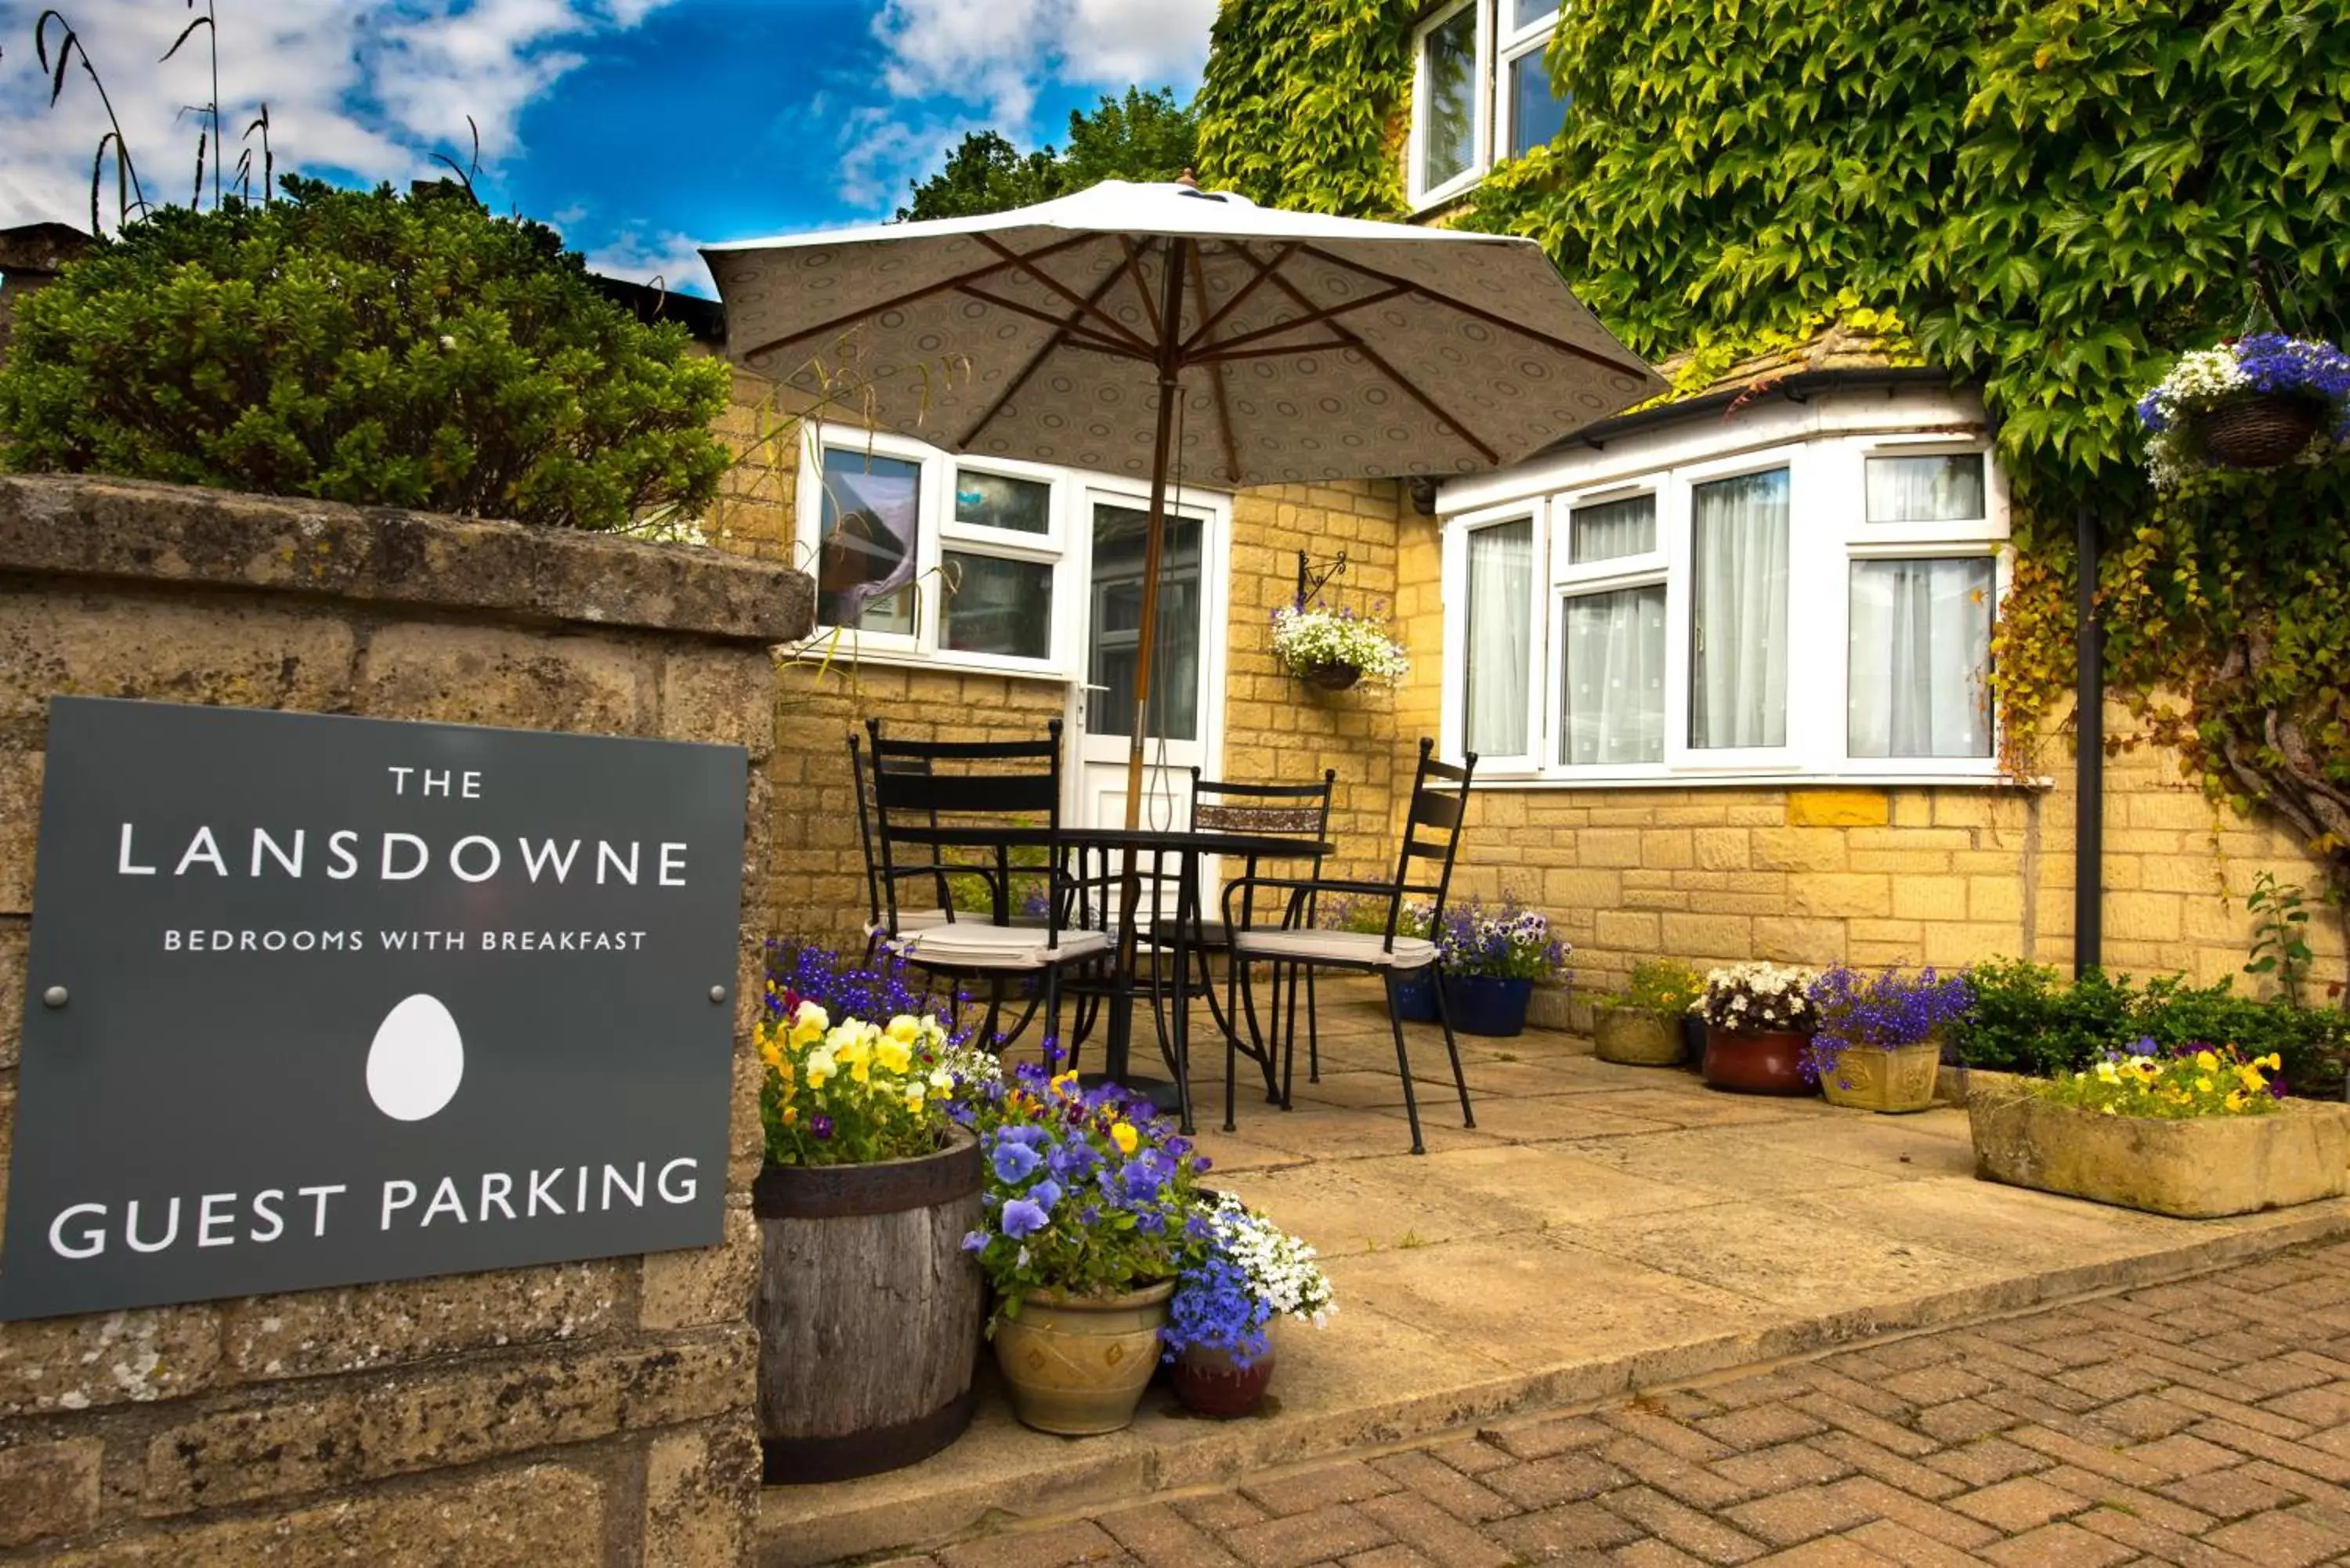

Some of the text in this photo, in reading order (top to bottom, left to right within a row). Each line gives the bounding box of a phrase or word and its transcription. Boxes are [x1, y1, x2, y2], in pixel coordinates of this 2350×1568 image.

[388, 766, 483, 799] THE
[118, 822, 688, 887] LANSDOWNE
[164, 930, 648, 952] BEDROOMS WITH BREAKFAST
[48, 1157, 699, 1259] GUEST PARKING
